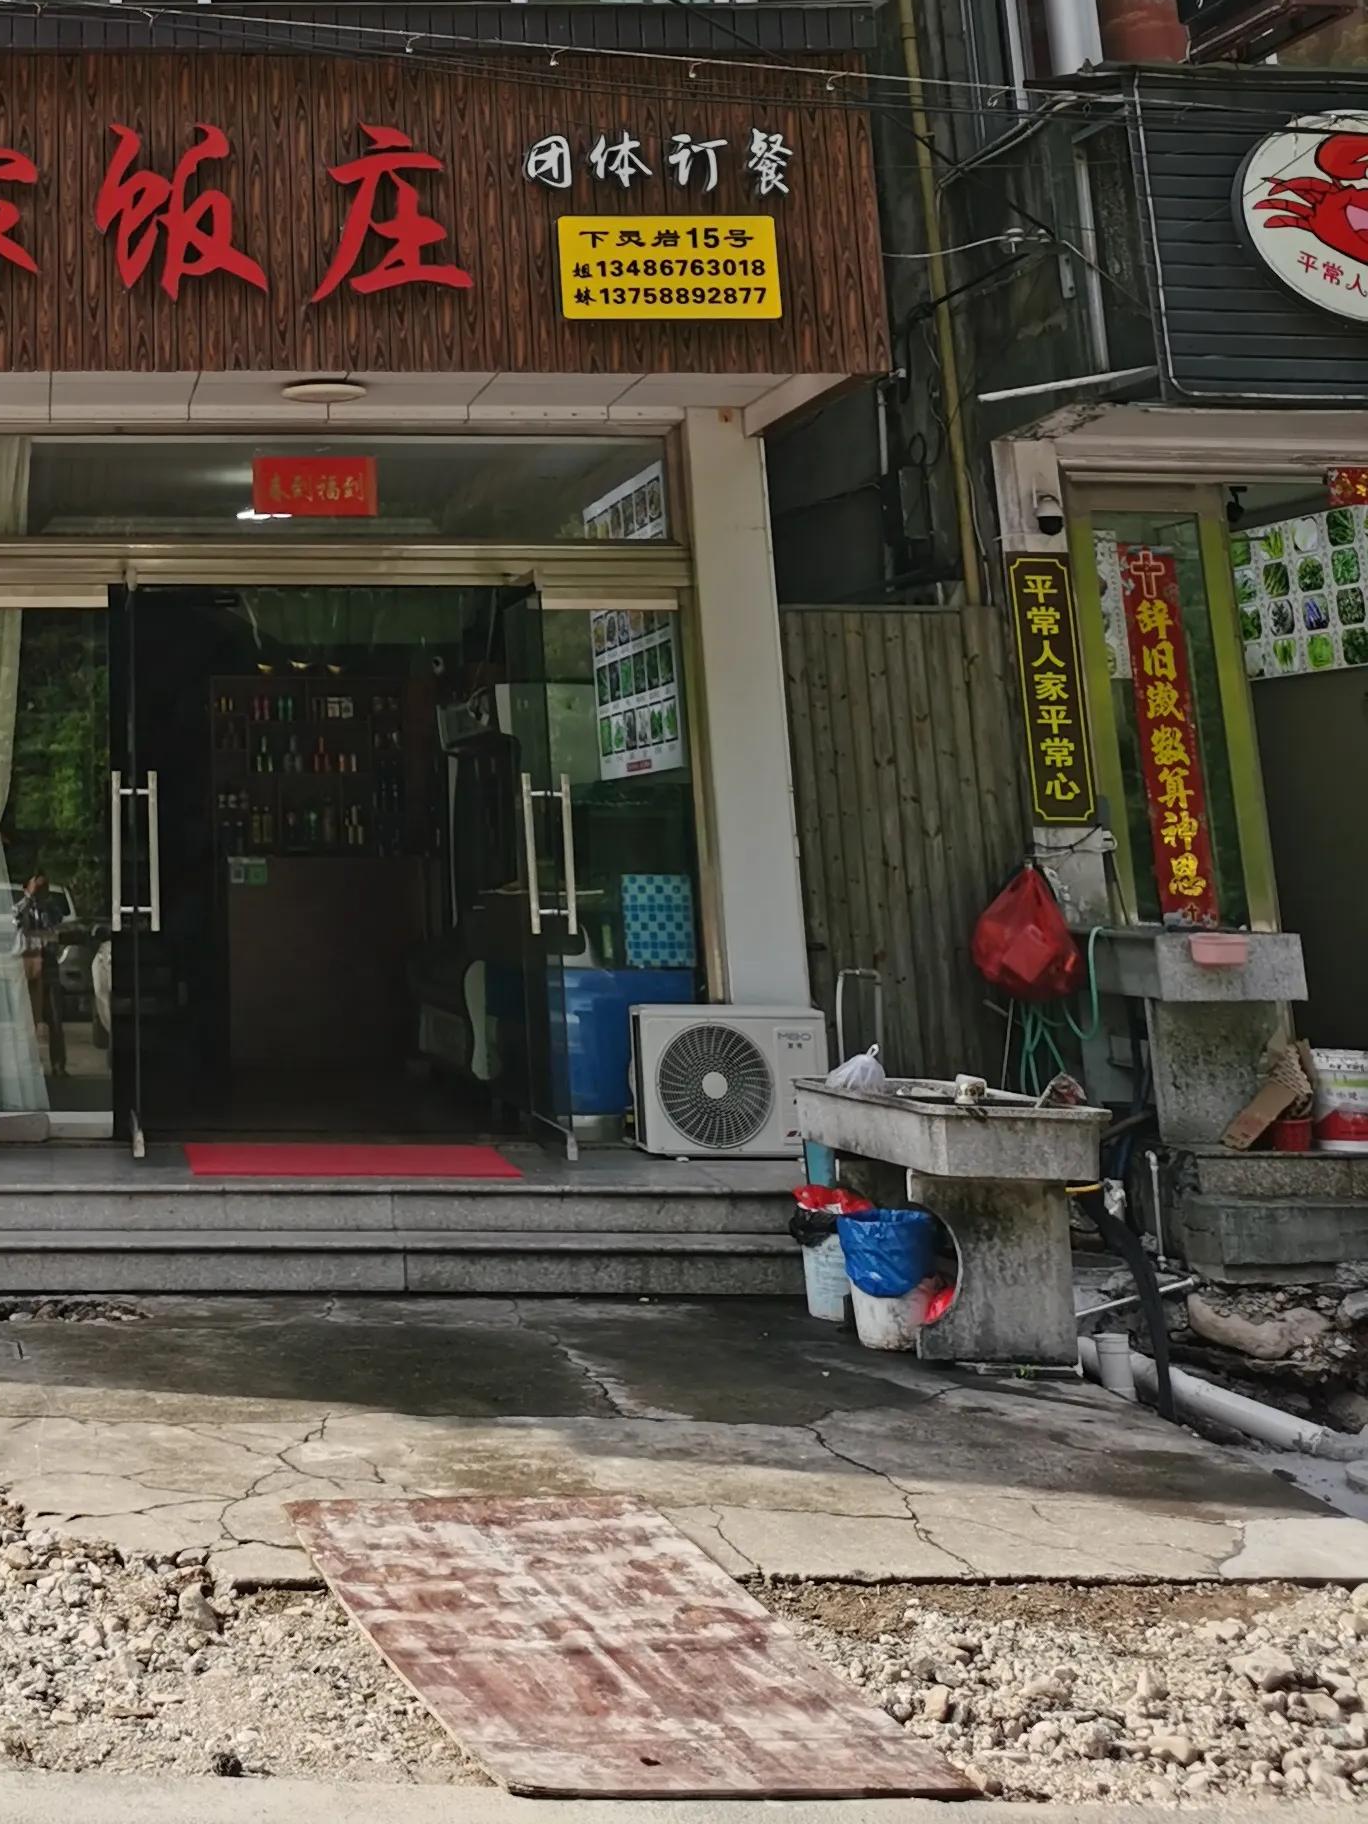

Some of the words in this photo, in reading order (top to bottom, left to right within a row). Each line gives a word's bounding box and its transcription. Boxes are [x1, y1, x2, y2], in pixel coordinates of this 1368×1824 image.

[524, 128, 794, 196] 团体订餐
[578, 228, 755, 249] 下灵岩15号
[572, 259, 767, 280] 姐13486763018
[1297, 250, 1368, 298] 平常人
[573, 287, 768, 307] 妹13758892877
[1023, 574, 1081, 801] 平常人家平常心
